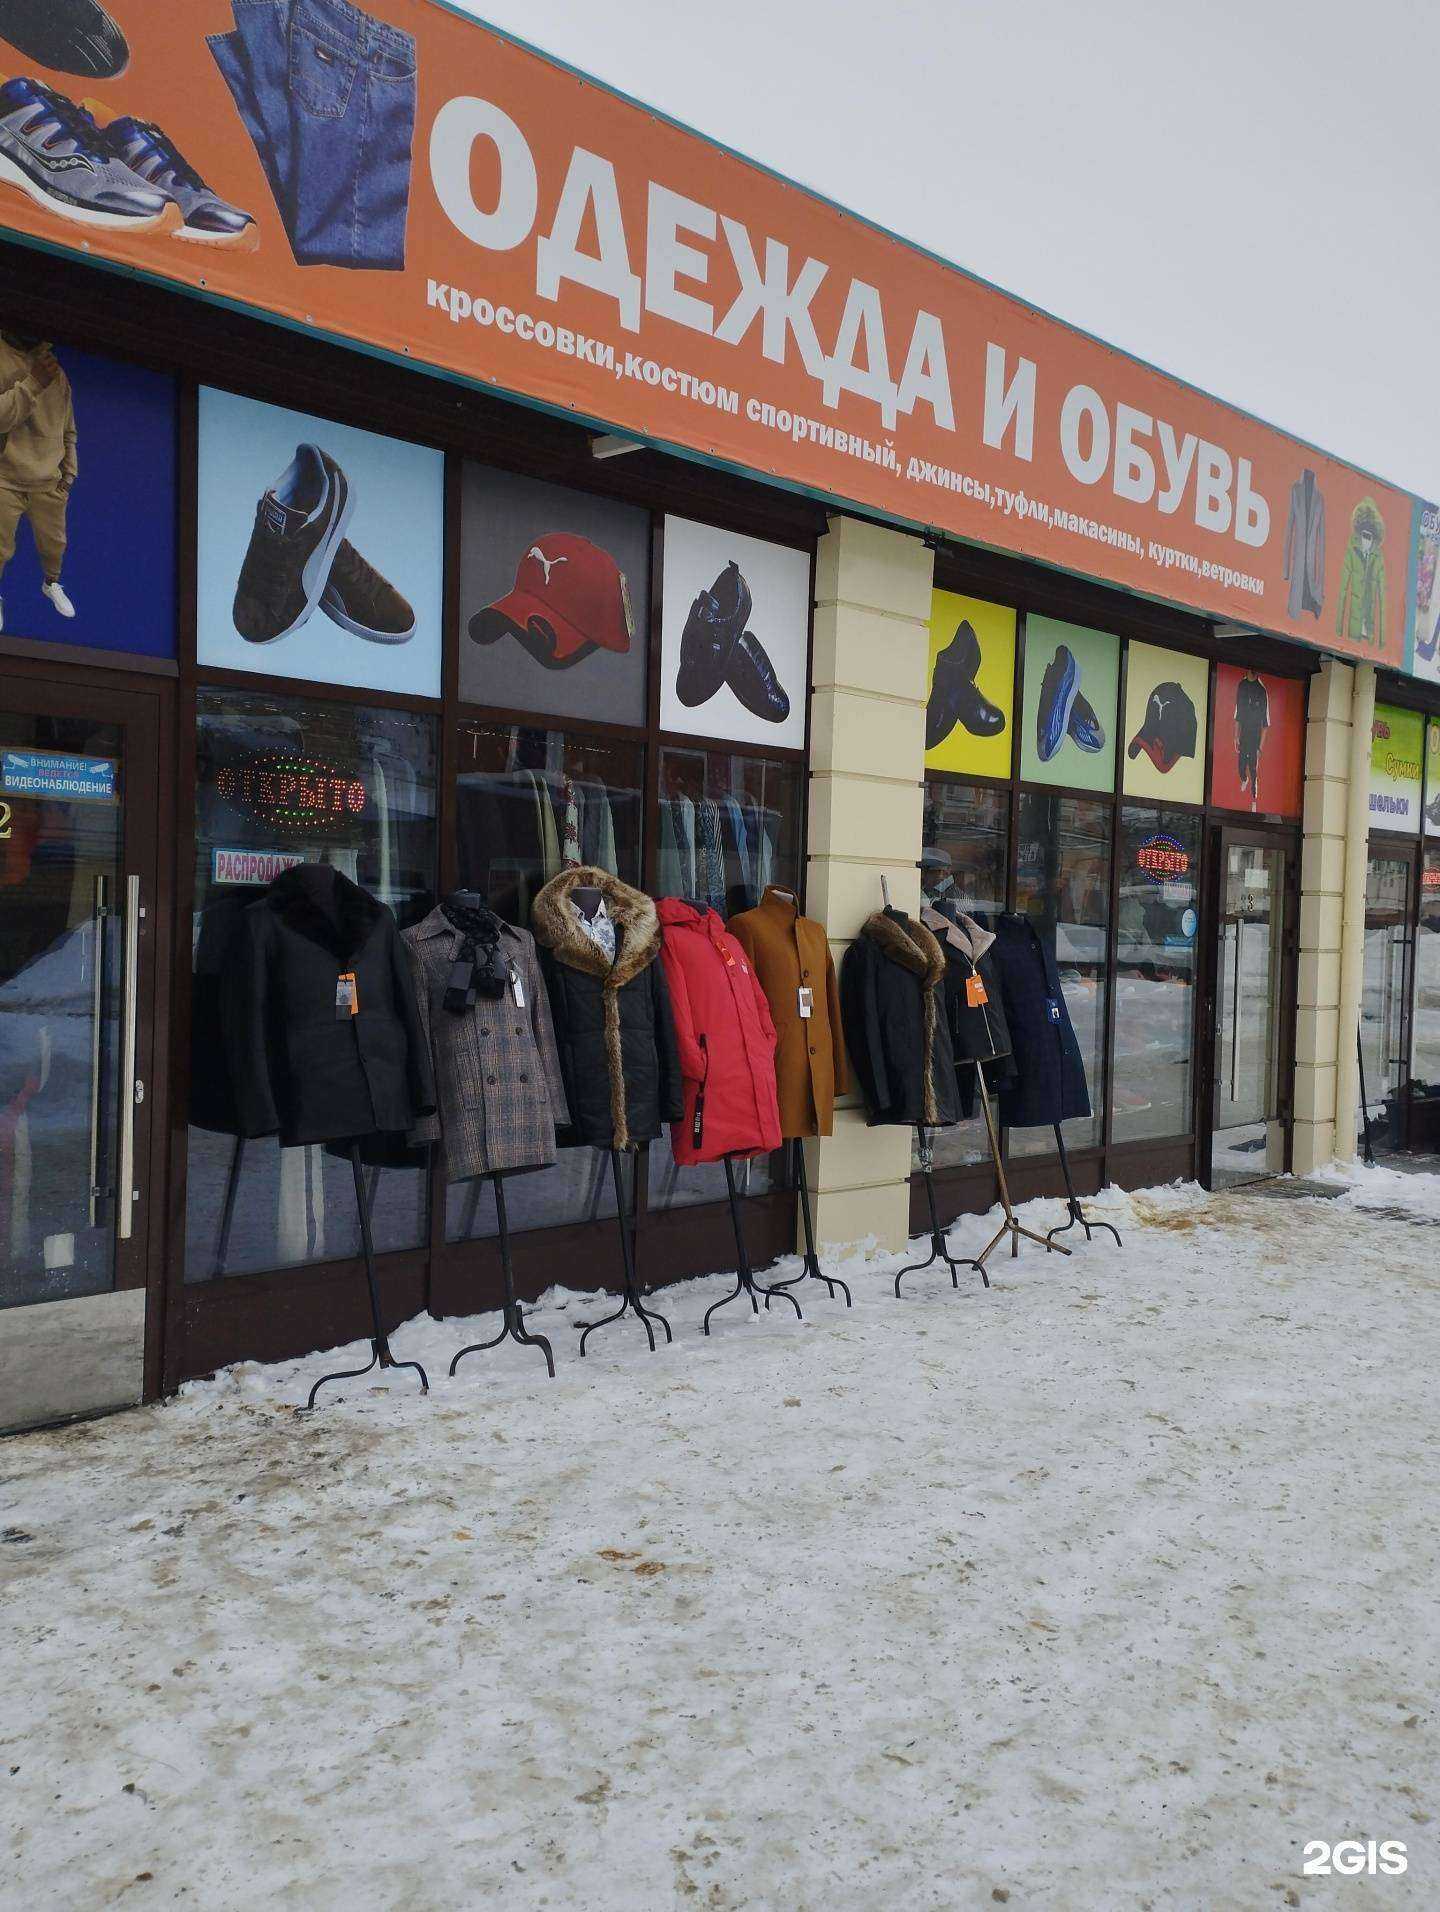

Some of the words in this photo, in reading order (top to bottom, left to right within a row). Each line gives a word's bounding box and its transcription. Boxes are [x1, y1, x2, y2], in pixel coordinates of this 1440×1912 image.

[430, 96, 955, 431] ОДЕЖДА
[983, 341, 1037, 462] И
[1060, 385, 1270, 547] ОБУВЬ
[747, 399, 901, 477] спортивный,
[31, 758, 87, 771] ВНИМАНИЕ!
[5, 775, 112, 794] ВИДЕОНАБЛЮДЕНИЕ
[216, 768, 364, 812] ОТКРЫТО
[218, 853, 302, 881] РАСПРОДАЖ
